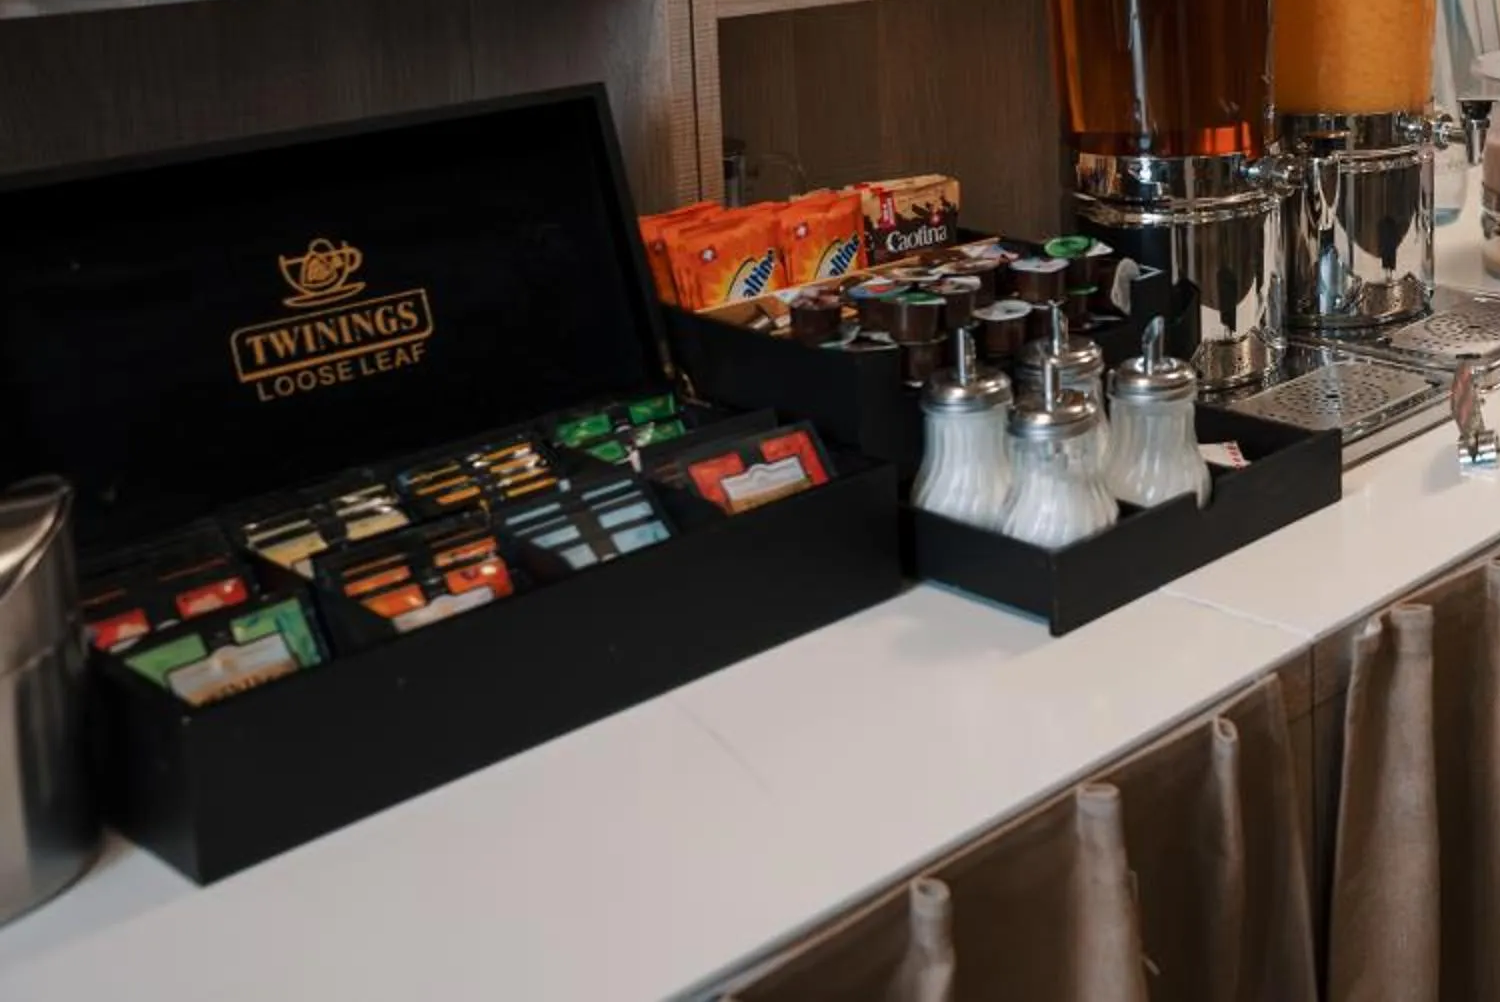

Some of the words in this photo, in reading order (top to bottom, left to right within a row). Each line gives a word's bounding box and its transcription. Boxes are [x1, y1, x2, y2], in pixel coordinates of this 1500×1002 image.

[886, 224, 947, 254] Caotina
[245, 299, 419, 366] TWININGS
[256, 360, 354, 402] LOOSE
[361, 342, 426, 376] LEAF
